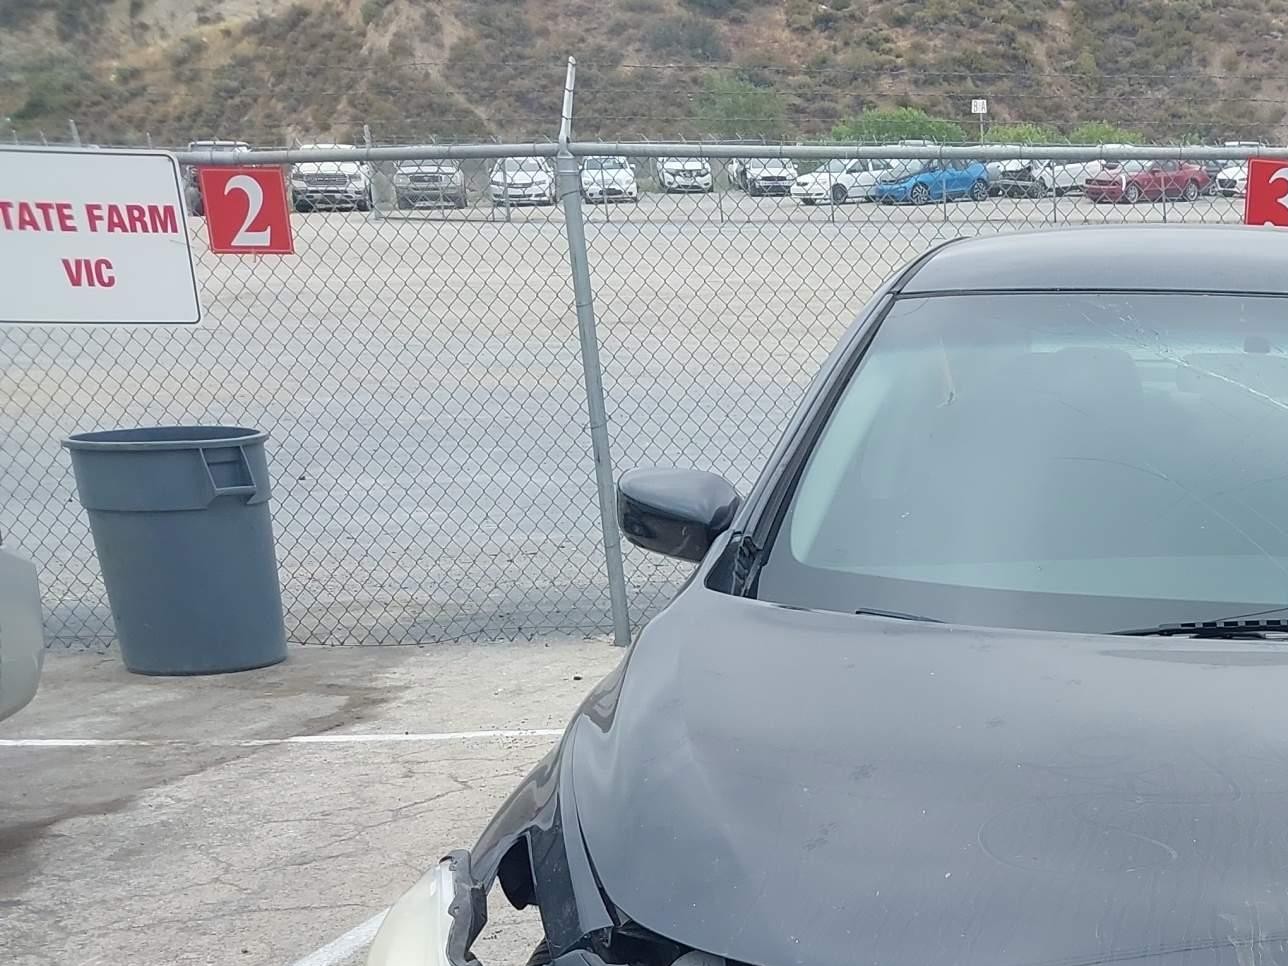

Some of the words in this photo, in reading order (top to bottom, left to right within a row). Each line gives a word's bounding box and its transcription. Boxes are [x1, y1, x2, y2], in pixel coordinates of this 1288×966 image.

[85, 204, 179, 234] FARM
[224, 175, 271, 247] 2
[61, 258, 116, 288] VIC
